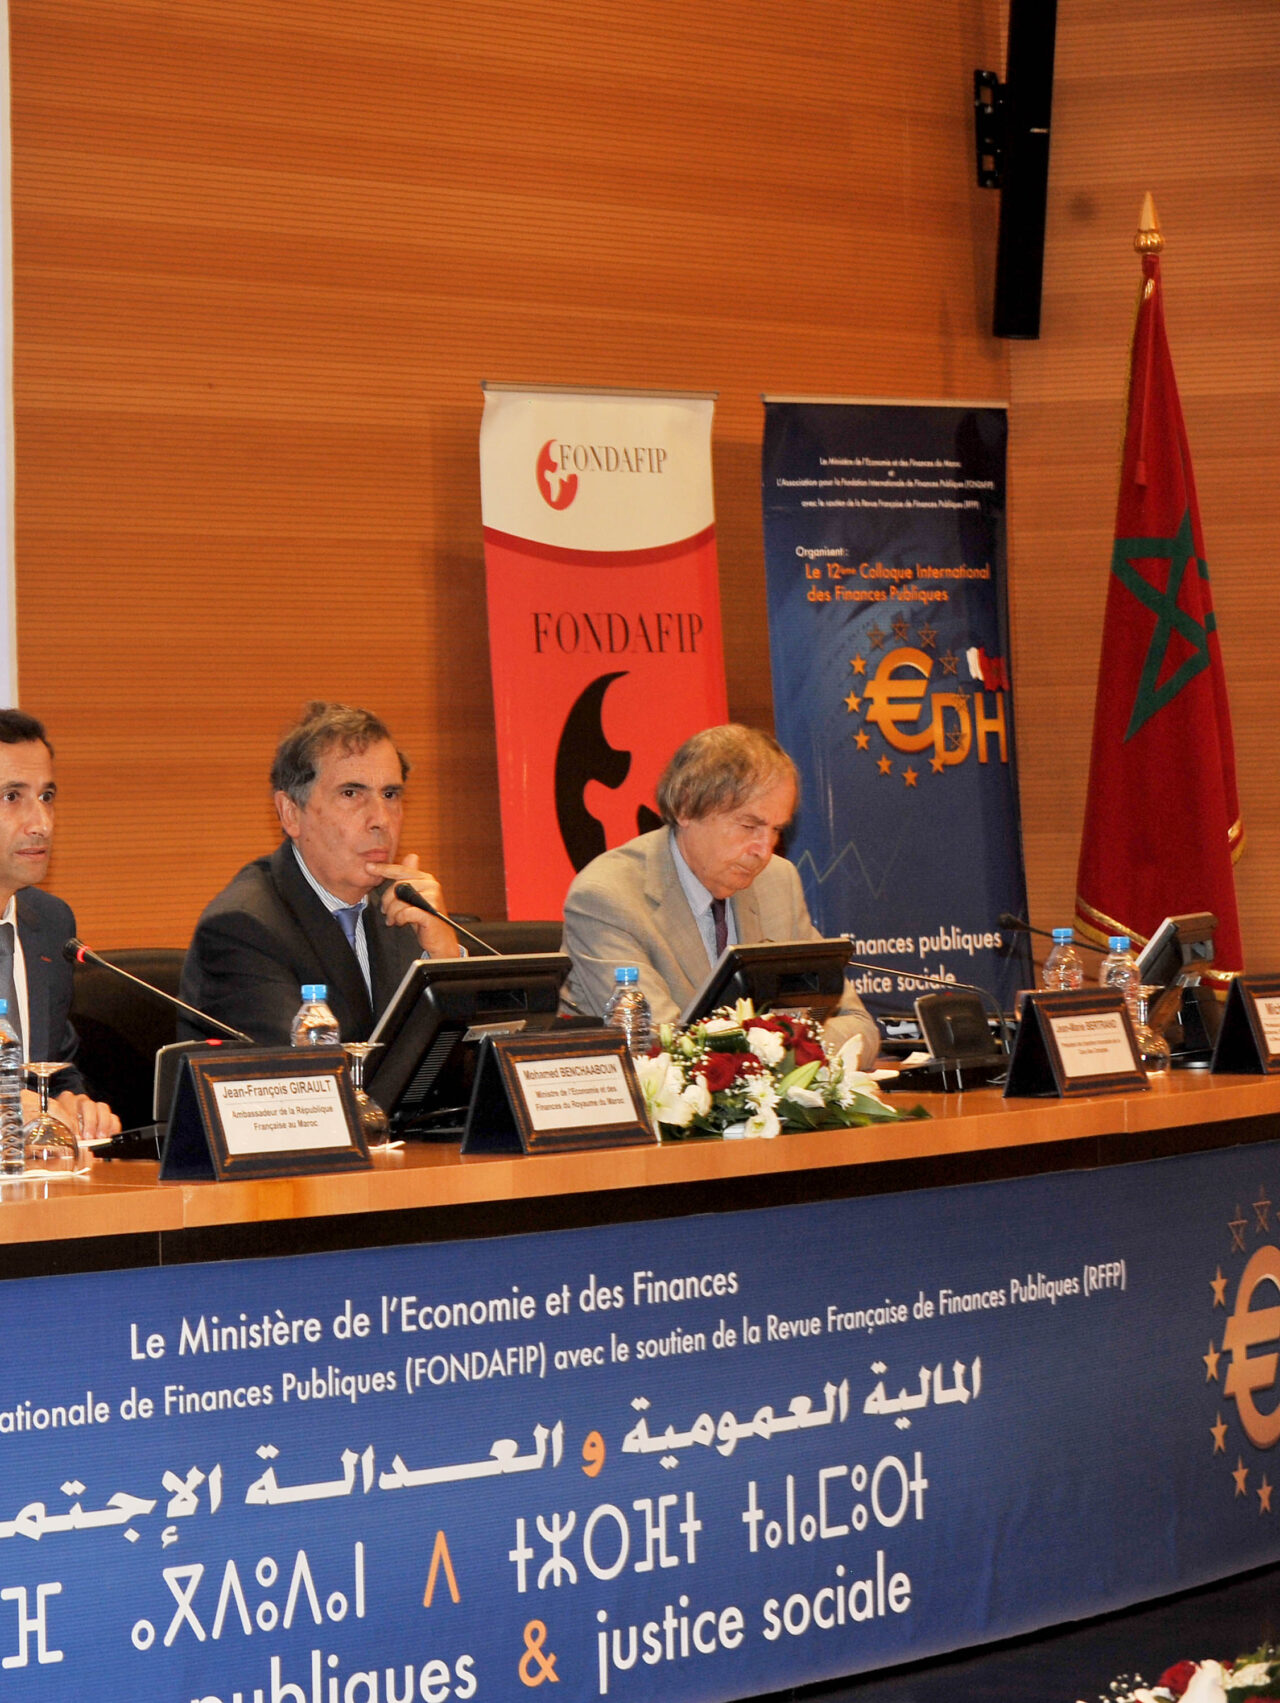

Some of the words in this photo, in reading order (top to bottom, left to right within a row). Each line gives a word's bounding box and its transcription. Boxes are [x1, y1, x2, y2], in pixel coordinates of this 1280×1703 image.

[558, 444, 668, 474] FONDAFIP
[795, 545, 844, 560] Organisent
[804, 563, 822, 580] Le
[859, 561, 914, 582] Colloque
[916, 562, 991, 580] International
[806, 585, 832, 603] des
[834, 584, 888, 602] Finances
[890, 585, 950, 605] Publiques
[530, 611, 704, 655] FONDAFIP
[918, 926, 1003, 959] publiques
[222, 1083, 288, 1099] Jean-François
[289, 1079, 332, 1094] GIRAULT
[523, 1067, 560, 1081] Mohamed
[232, 1107, 278, 1119] Ambassadeur
[279, 1106, 288, 1116] de
[289, 1106, 295, 1115] la
[296, 1104, 334, 1116] République
[536, 1102, 563, 1112] Finances
[571, 1100, 598, 1111] Royaume
[608, 1097, 624, 1106] Maroc
[253, 1120, 287, 1132] Française
[288, 1121, 296, 1129] au
[298, 1118, 318, 1128] Maroc
[130, 1323, 166, 1361] Le
[178, 1309, 321, 1356] Ministère
[332, 1299, 370, 1339] de
[381, 1286, 537, 1334] l'Economie
[545, 1284, 571, 1316] et
[579, 1274, 625, 1312] des
[633, 1270, 739, 1306] Finances
[119, 1386, 155, 1421] de
[163, 1384, 274, 1416] Finances
[282, 1365, 397, 1404] Publiques
[404, 1341, 547, 1395] (FONDAFIP)
[553, 1344, 605, 1371] avec
[610, 1332, 629, 1363] le
[636, 1327, 706, 1360] soutien
[712, 1318, 737, 1349] de
[742, 1315, 761, 1345] la
[766, 1313, 821, 1343] Revue
[826, 1299, 908, 1334] Française
[912, 1291, 935, 1320] de
[938, 1288, 1007, 1316] Finances
[1010, 1272, 1081, 1305] Publiques
[1083, 1258, 1127, 1297] (RFFP)
[862, 1355, 982, 1431] المالية
[620, 1377, 850, 1470] العمومية
[243, 1419, 565, 1506] العدالة
[581, 1430, 606, 1478] و
[517, 1618, 559, 1688] &
[597, 1594, 745, 1695] justice
[763, 1549, 913, 1642] sociale
